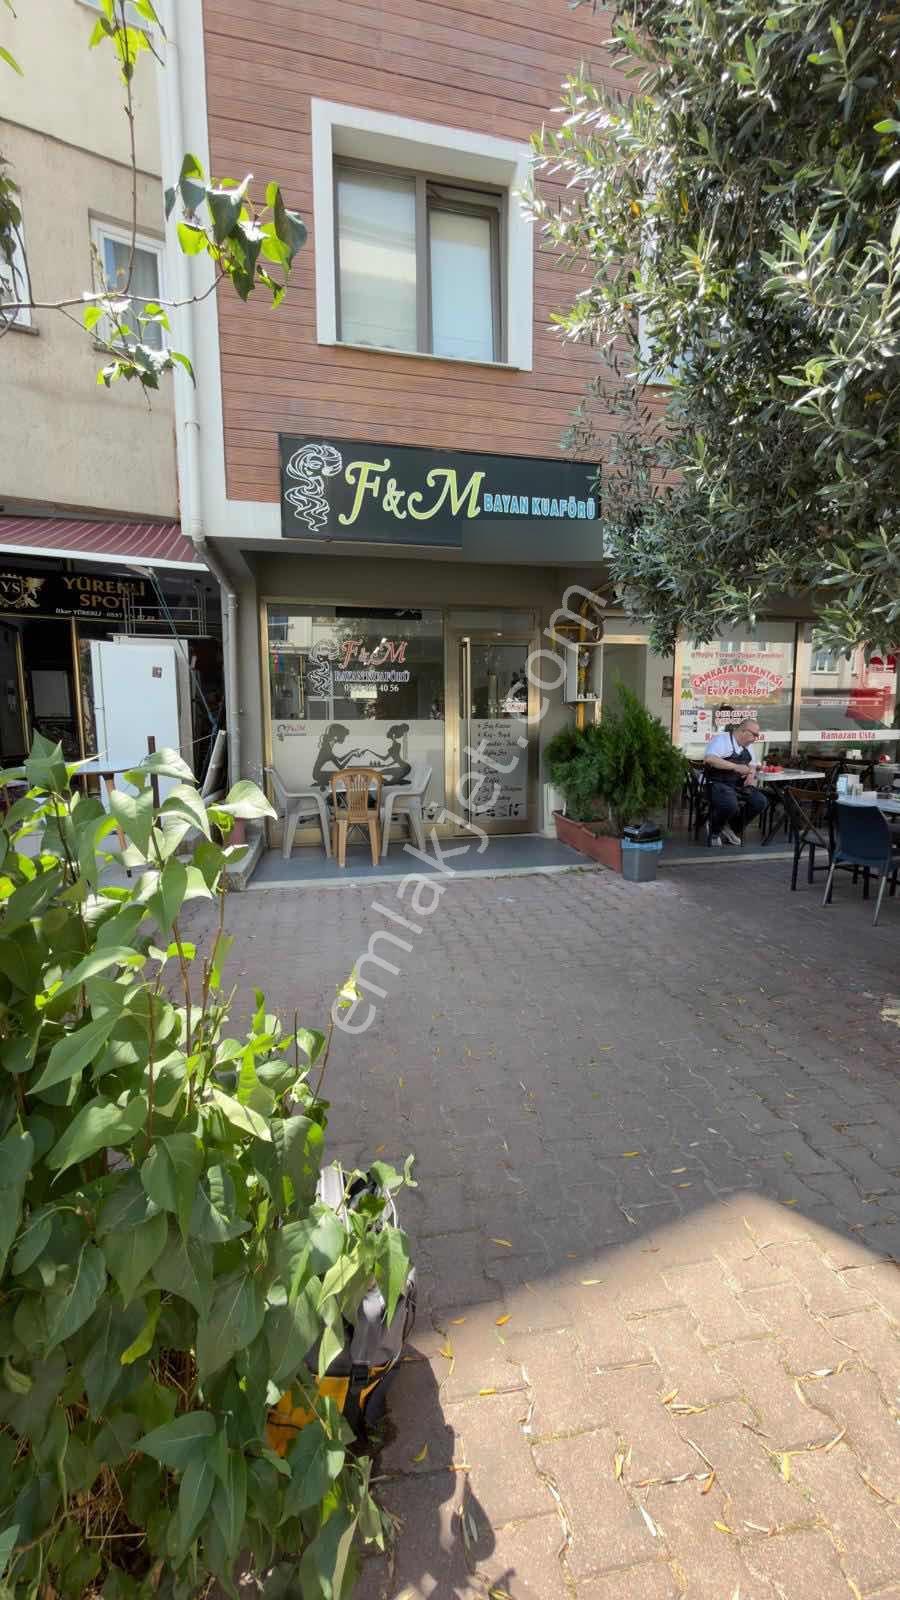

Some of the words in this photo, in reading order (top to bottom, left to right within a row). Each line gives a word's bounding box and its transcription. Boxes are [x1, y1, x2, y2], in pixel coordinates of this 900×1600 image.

[338, 458, 485, 525] F&M
[483, 493, 529, 514] BAYAN
[531, 496, 596, 519] KUAFÖRÜ
[79, 593, 128, 609] SPOT
[820, 731, 857, 741] Ramazan
[859, 731, 876, 741] Usta
